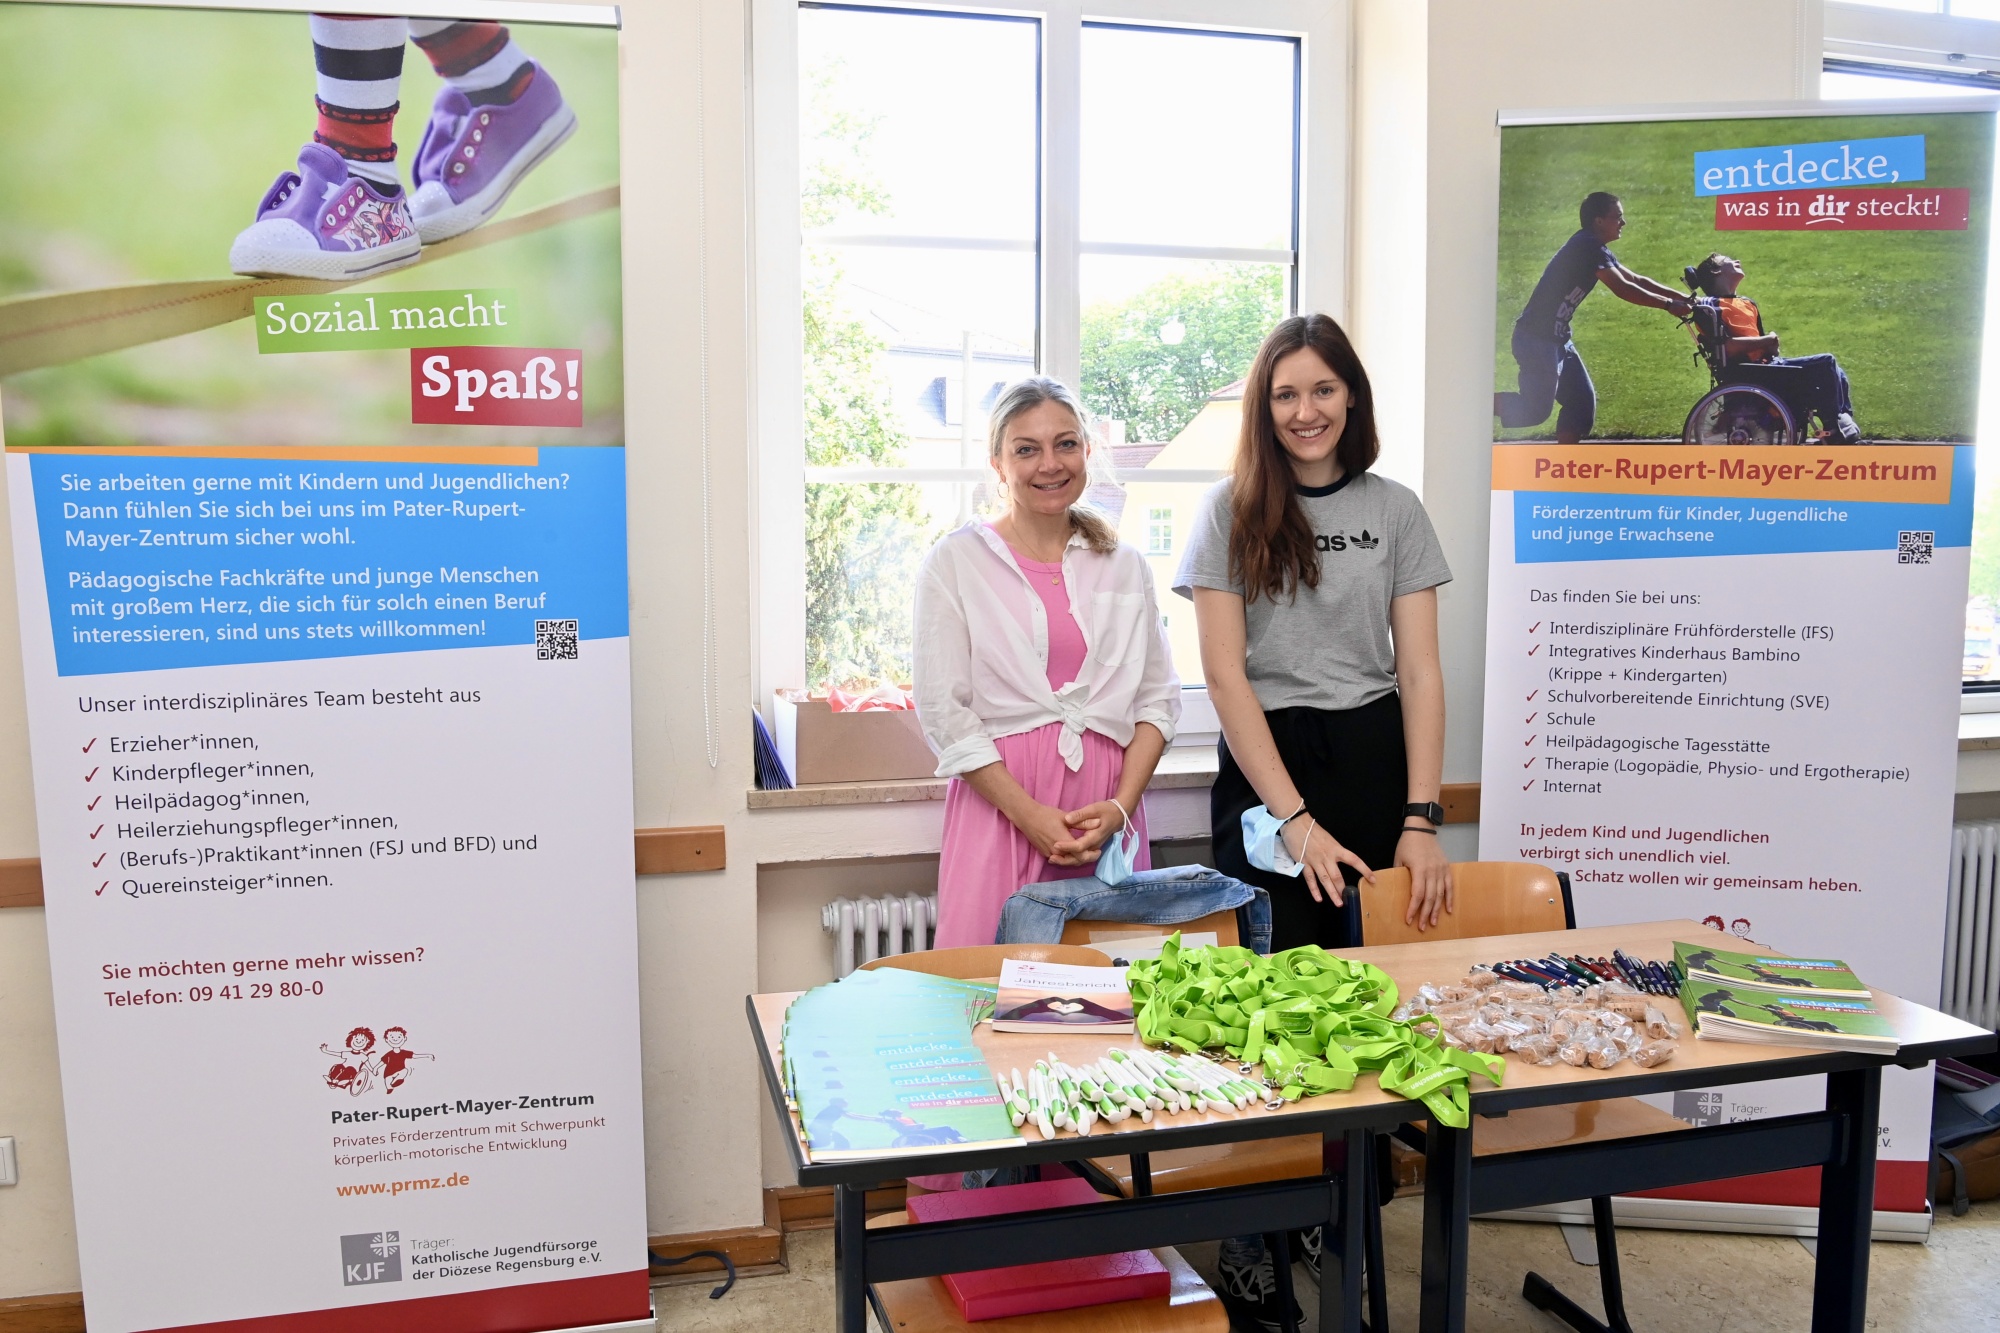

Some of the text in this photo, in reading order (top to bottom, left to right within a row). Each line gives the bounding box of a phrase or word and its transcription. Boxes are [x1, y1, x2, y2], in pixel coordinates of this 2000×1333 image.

[1703, 145, 1899, 191] entdecke,
[1723, 195, 1939, 216] was in dir steckt!
[266, 294, 507, 334] Sozial macht
[422, 355, 579, 412] Spaß!
[1535, 458, 1936, 485] Pater-Rupert-Mayer-Zentrum
[61, 472, 569, 495] Sie arbeiten gerne mit Kindern und Jugendlichen?
[63, 500, 525, 521] Dann fühlen Sie sich bei uns im Pater-Rupert-
[1533, 505, 1847, 524] Förderzentrum für Kinder, Jugendliche
[66, 527, 355, 551] Mayer-Zentrum sicher wohl.
[1532, 526, 1714, 544] und junge Erwachsene
[69, 566, 538, 592] Pädagogische Fachkräfte und junge Menschen
[71, 592, 546, 619] mit großem Herz, die sich für solch einen Beruf
[1531, 589, 1700, 604] Das finden Sie bei uns:
[73, 620, 485, 642] interessieren, sind uns stets willkommen!
[1550, 622, 1833, 641] Interdisziplinäre Frühförderstelle (IFS)
[1549, 644, 1799, 661] Integratives Kinderhaus Bambino
[1549, 667, 1726, 685] (Krippe Kindergarten)
[79, 687, 480, 712] Unser interdisziplinäres Team besteht aus
[1548, 689, 1828, 711] Schulvorbereitende Einrichtung (SVE)
[1547, 712, 1595, 725] Schule
[1546, 735, 1769, 754] Heilpädagogische Tagesstätte
[1545, 757, 1909, 782] Therapie (Logopädie, Physio- und Ergotherapie)
[1544, 780, 1601, 793] Internat
[1521, 823, 1768, 844] In jedem Kind und Jugendlichen
[370, 840, 403, 859] (FSJ
[411, 837, 446, 853] und
[454, 836, 495, 853] BFD)
[503, 834, 536, 850] und
[1520, 846, 1729, 864] verbirgt sich unendlich viel.
[1575, 869, 1861, 892] Schatz wollen wir gemeinsam heben.
[102, 947, 424, 979] Sie möchten gerne mehr wissen?
[104, 980, 323, 1006] Telefon: 09 41 29 80-0
[1014, 978, 1117, 988] Jahresbericht
[880, 1043, 953, 1056] entdecke,
[890, 1056, 965, 1070] entdecke,
[894, 1073, 971, 1086] entdecke,
[900, 1090, 978, 1103] entdecke,
[332, 1095, 593, 1123] Pater-Rupert-Mayer-Zentrum
[1731, 1103, 1768, 1115] Träger:
[333, 1116, 605, 1147] Privates Förderzentrum mit Schwerpunkt
[334, 1138, 566, 1166] körperlich-motorische Entwicklung
[336, 1172, 469, 1196] www.prmz.de
[410, 1239, 457, 1251] Träger:
[412, 1240, 597, 1264] Katholische Jugendfürsorge
[347, 1262, 385, 1282] KJF
[413, 1252, 601, 1279] der Diözese Regensburg e.V.
